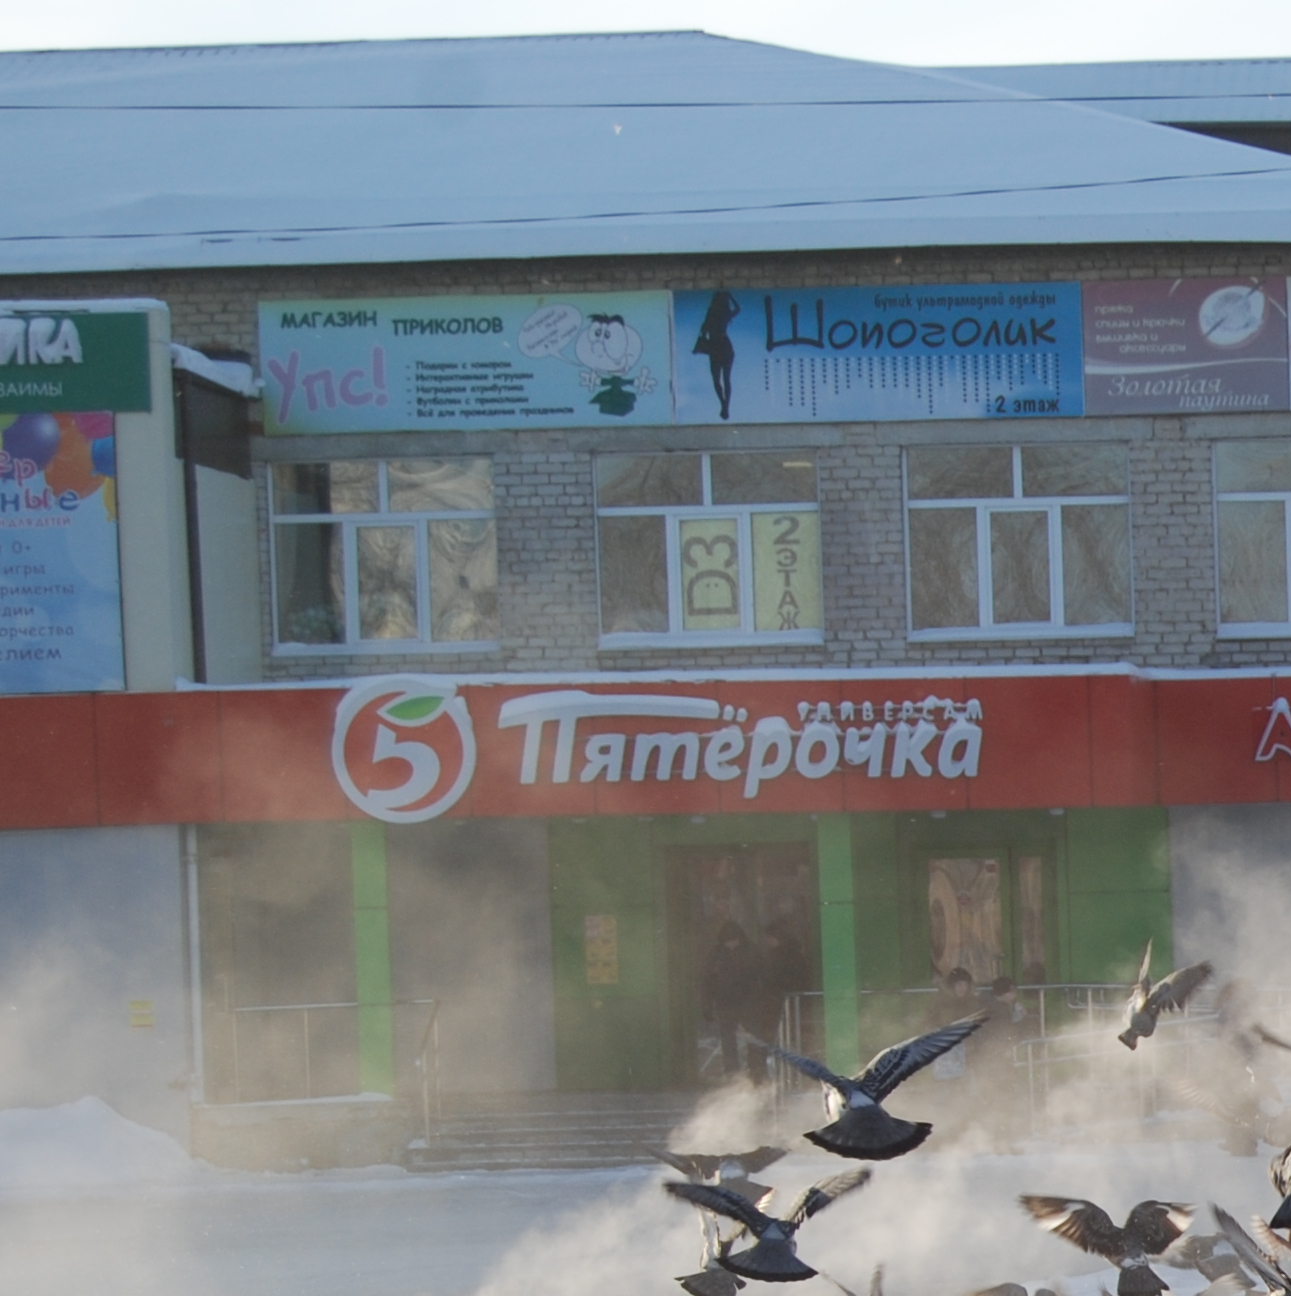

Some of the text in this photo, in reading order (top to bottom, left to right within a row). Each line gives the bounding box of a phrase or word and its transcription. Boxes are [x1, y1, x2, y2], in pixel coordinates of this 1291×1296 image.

[281, 311, 378, 329] МАГАЗИН
[392, 317, 504, 336] ПРИКОЛОВ
[764, 295, 1056, 352] Шопоголик
[267, 346, 389, 424] Упс!
[1108, 373, 1222, 396] Золотая
[995, 395, 1060, 413] 2 этаж
[1178, 391, 1270, 411] паутина
[773, 515, 800, 545] 2
[776, 548, 801, 631] ЭТАЖ
[797, 698, 983, 722] УНИВЕРСАМ
[498, 689, 983, 799] Пятёрочка
